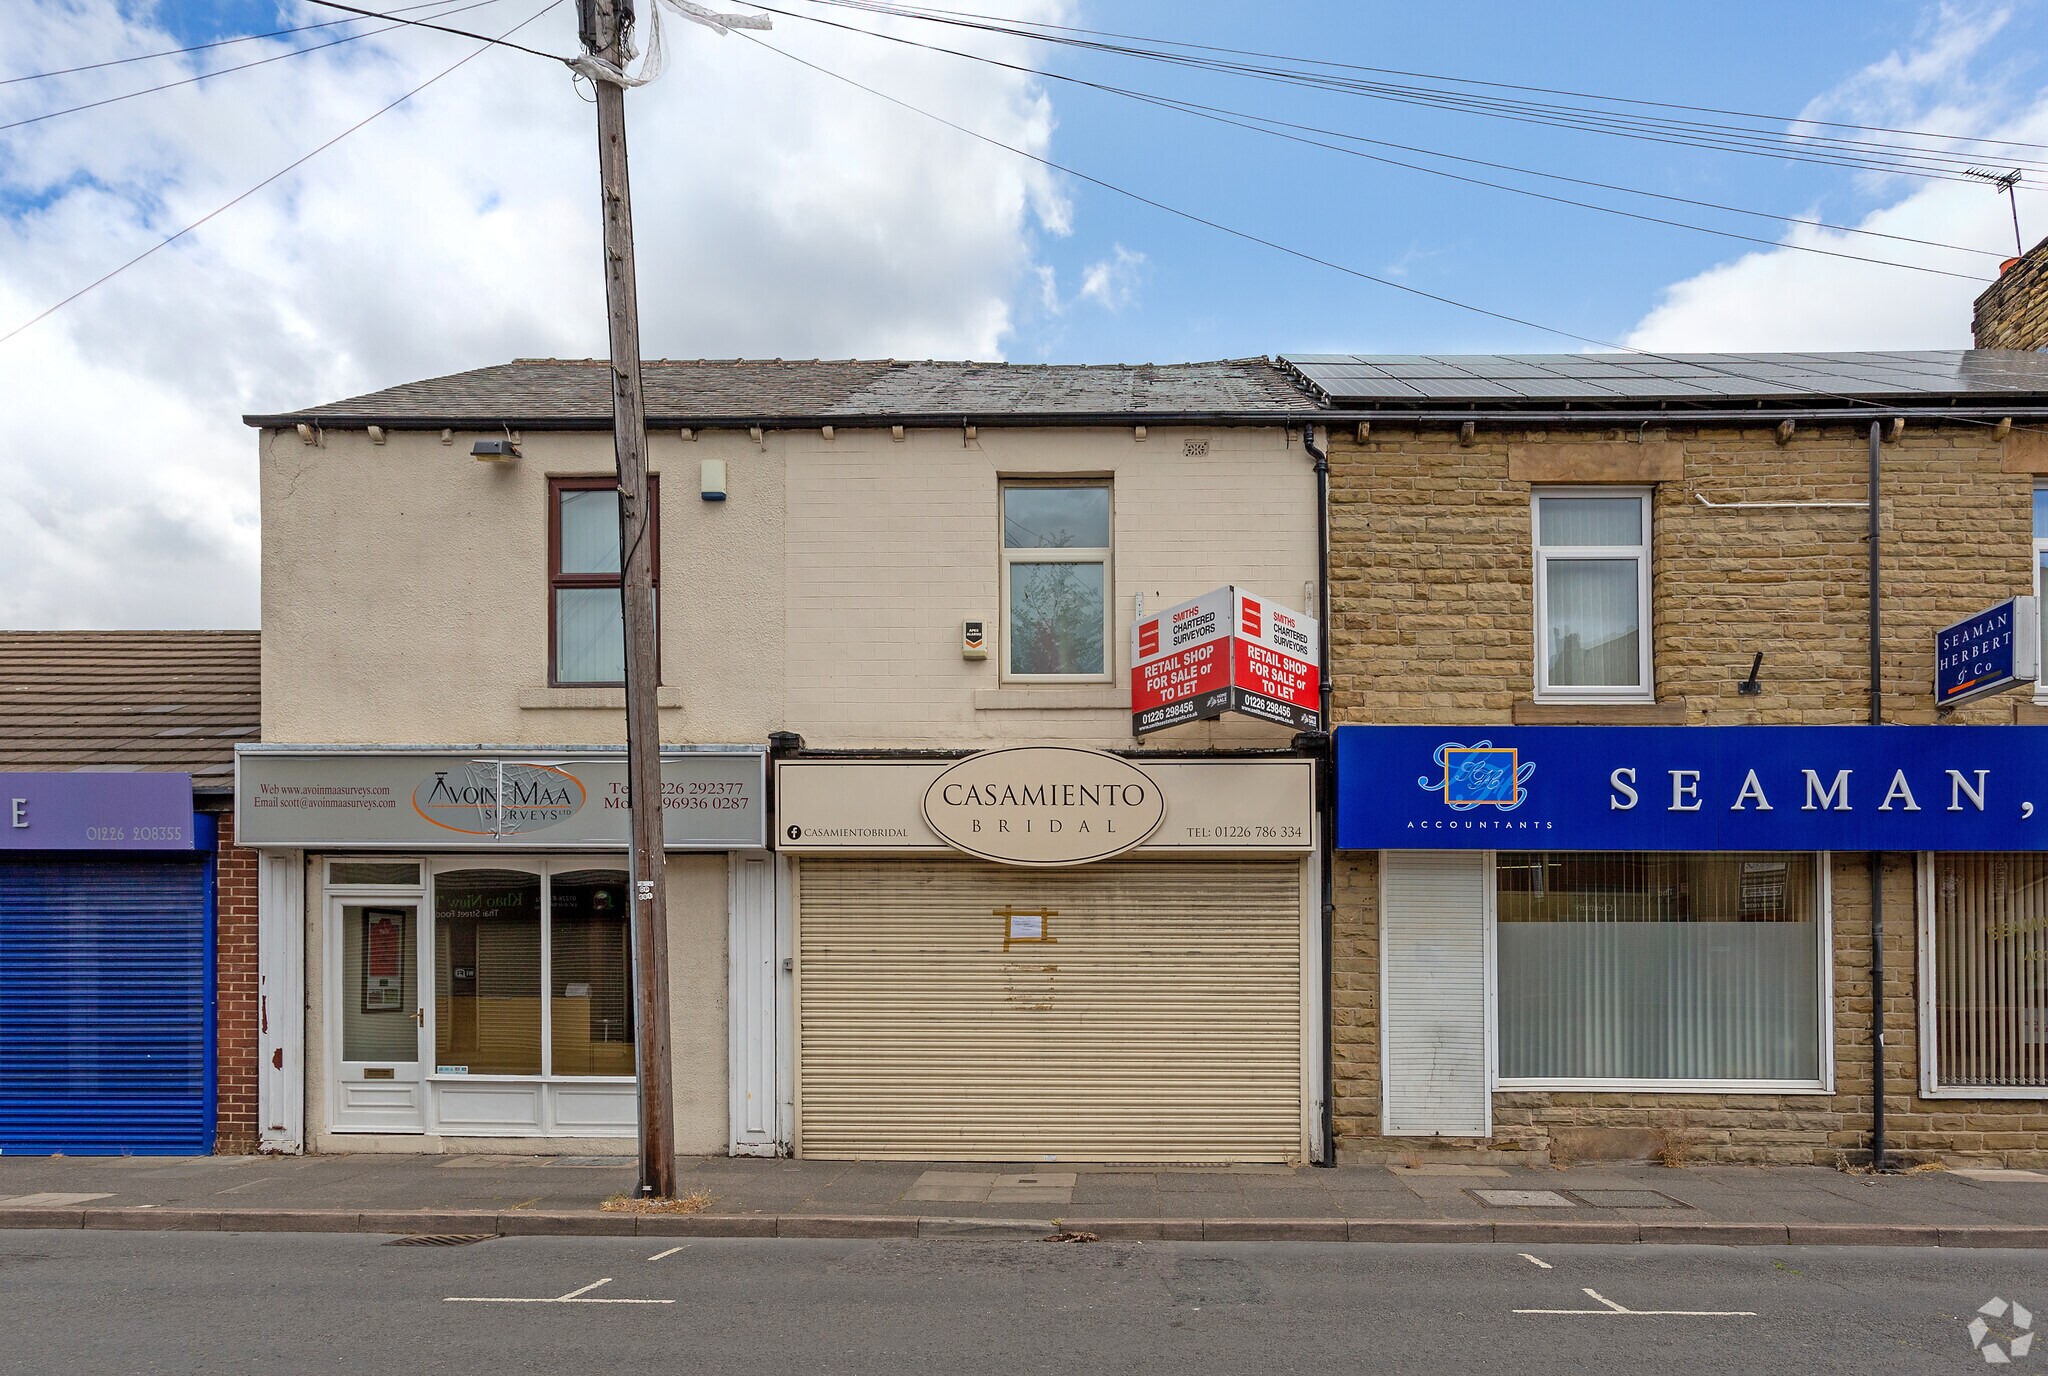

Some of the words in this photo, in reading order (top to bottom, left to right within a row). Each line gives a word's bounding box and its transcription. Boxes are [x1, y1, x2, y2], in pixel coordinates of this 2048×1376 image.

[1173, 606, 1199, 623] SMITHS
[1173, 612, 1216, 634] CHARTERED
[1273, 611, 1296, 628] SMITHS
[1173, 623, 1216, 646] SURVEYORS
[1273, 623, 1308, 644] CHARTERED
[1942, 613, 2008, 650] SEAMAN
[1273, 634, 1308, 655] SURVEYORS
[1939, 631, 2011, 671] HERBERT
[1144, 655, 1181, 679] RETAIL
[1183, 645, 1214, 666] SHOP
[1247, 645, 1281, 669] RETAIL
[1283, 655, 1307, 676] SHOP
[1974, 661, 1993, 675] Co
[1146, 675, 1168, 692] FOR
[1170, 667, 1198, 686] SALE
[1200, 663, 1213, 675] or
[1249, 661, 1270, 678] FOR
[1271, 668, 1295, 687] SALE
[1296, 678, 1307, 690] or
[1160, 687, 1175, 702] TO
[1177, 680, 1198, 697] LET
[1262, 679, 1277, 695] TO
[1278, 685, 1295, 701] LET
[1142, 710, 1164, 725] 01226
[1165, 701, 1194, 718] 298456
[1245, 694, 1266, 711] 01226
[1266, 702, 1291, 718] 298456
[260, 784, 279, 795] Web
[281, 784, 390, 797] www.avoinmaasurveys.com
[514, 782, 571, 805] MAA
[609, 782, 630, 794] Te
[689, 782, 743, 794] 292377
[943, 784, 1145, 807] CASAMIENTO
[1610, 768, 2034, 819] SEAMAN,
[254, 797, 278, 808] Email
[280, 797, 396, 810] scott@avoinmaasurveys.com
[604, 797, 631, 809] Mo
[713, 797, 749, 809] 0287
[486, 810, 558, 820] SURVEYS
[1407, 820, 1553, 829] ACCOUNTANTS
[87, 827, 124, 841] 01226
[133, 827, 181, 841] 208355
[804, 828, 909, 837] CASAMIENTOBRIDAL
[972, 819, 1116, 833] BRIDAL
[1187, 827, 1211, 838] TEL:
[1215, 826, 1251, 838] 01226
[1255, 826, 1277, 838] 786
[1280, 826, 1302, 838] 334
